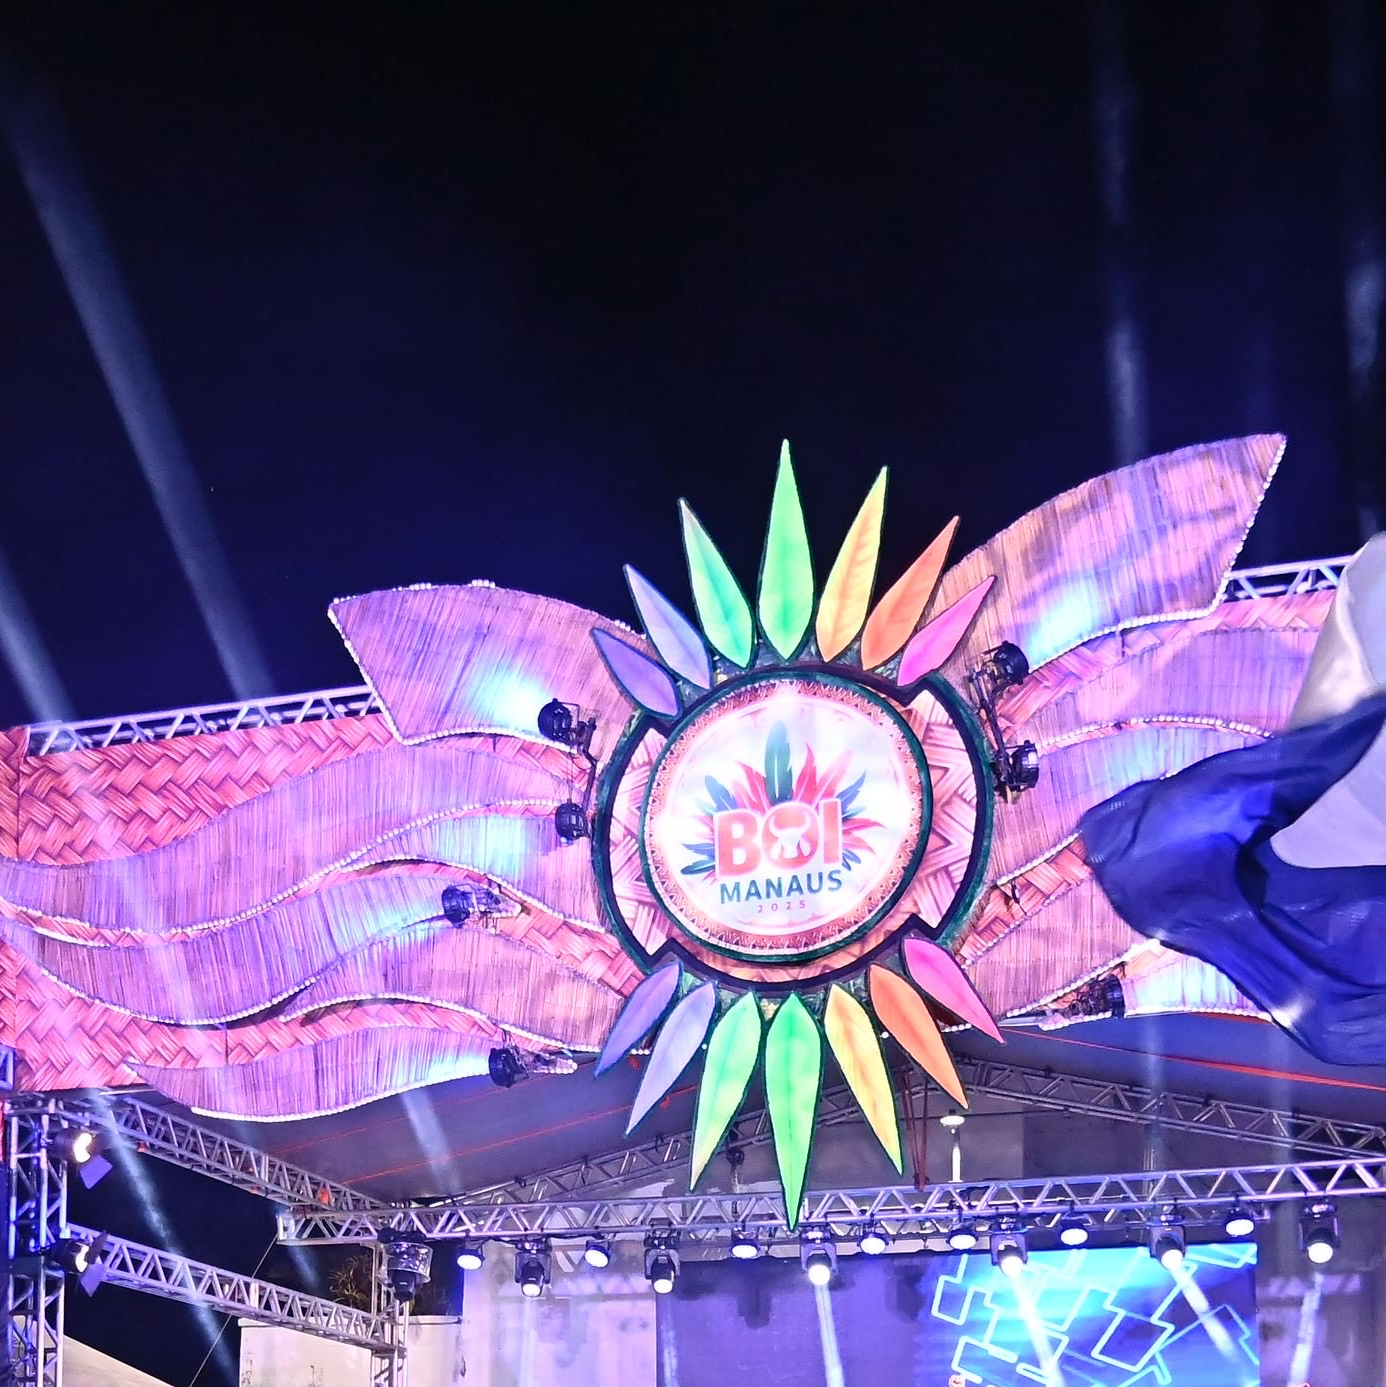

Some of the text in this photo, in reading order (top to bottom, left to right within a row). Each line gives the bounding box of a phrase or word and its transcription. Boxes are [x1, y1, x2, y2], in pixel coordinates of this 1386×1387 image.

[717, 799, 844, 877] BOI
[719, 868, 843, 904] MANAUS
[757, 899, 806, 914] 2025
